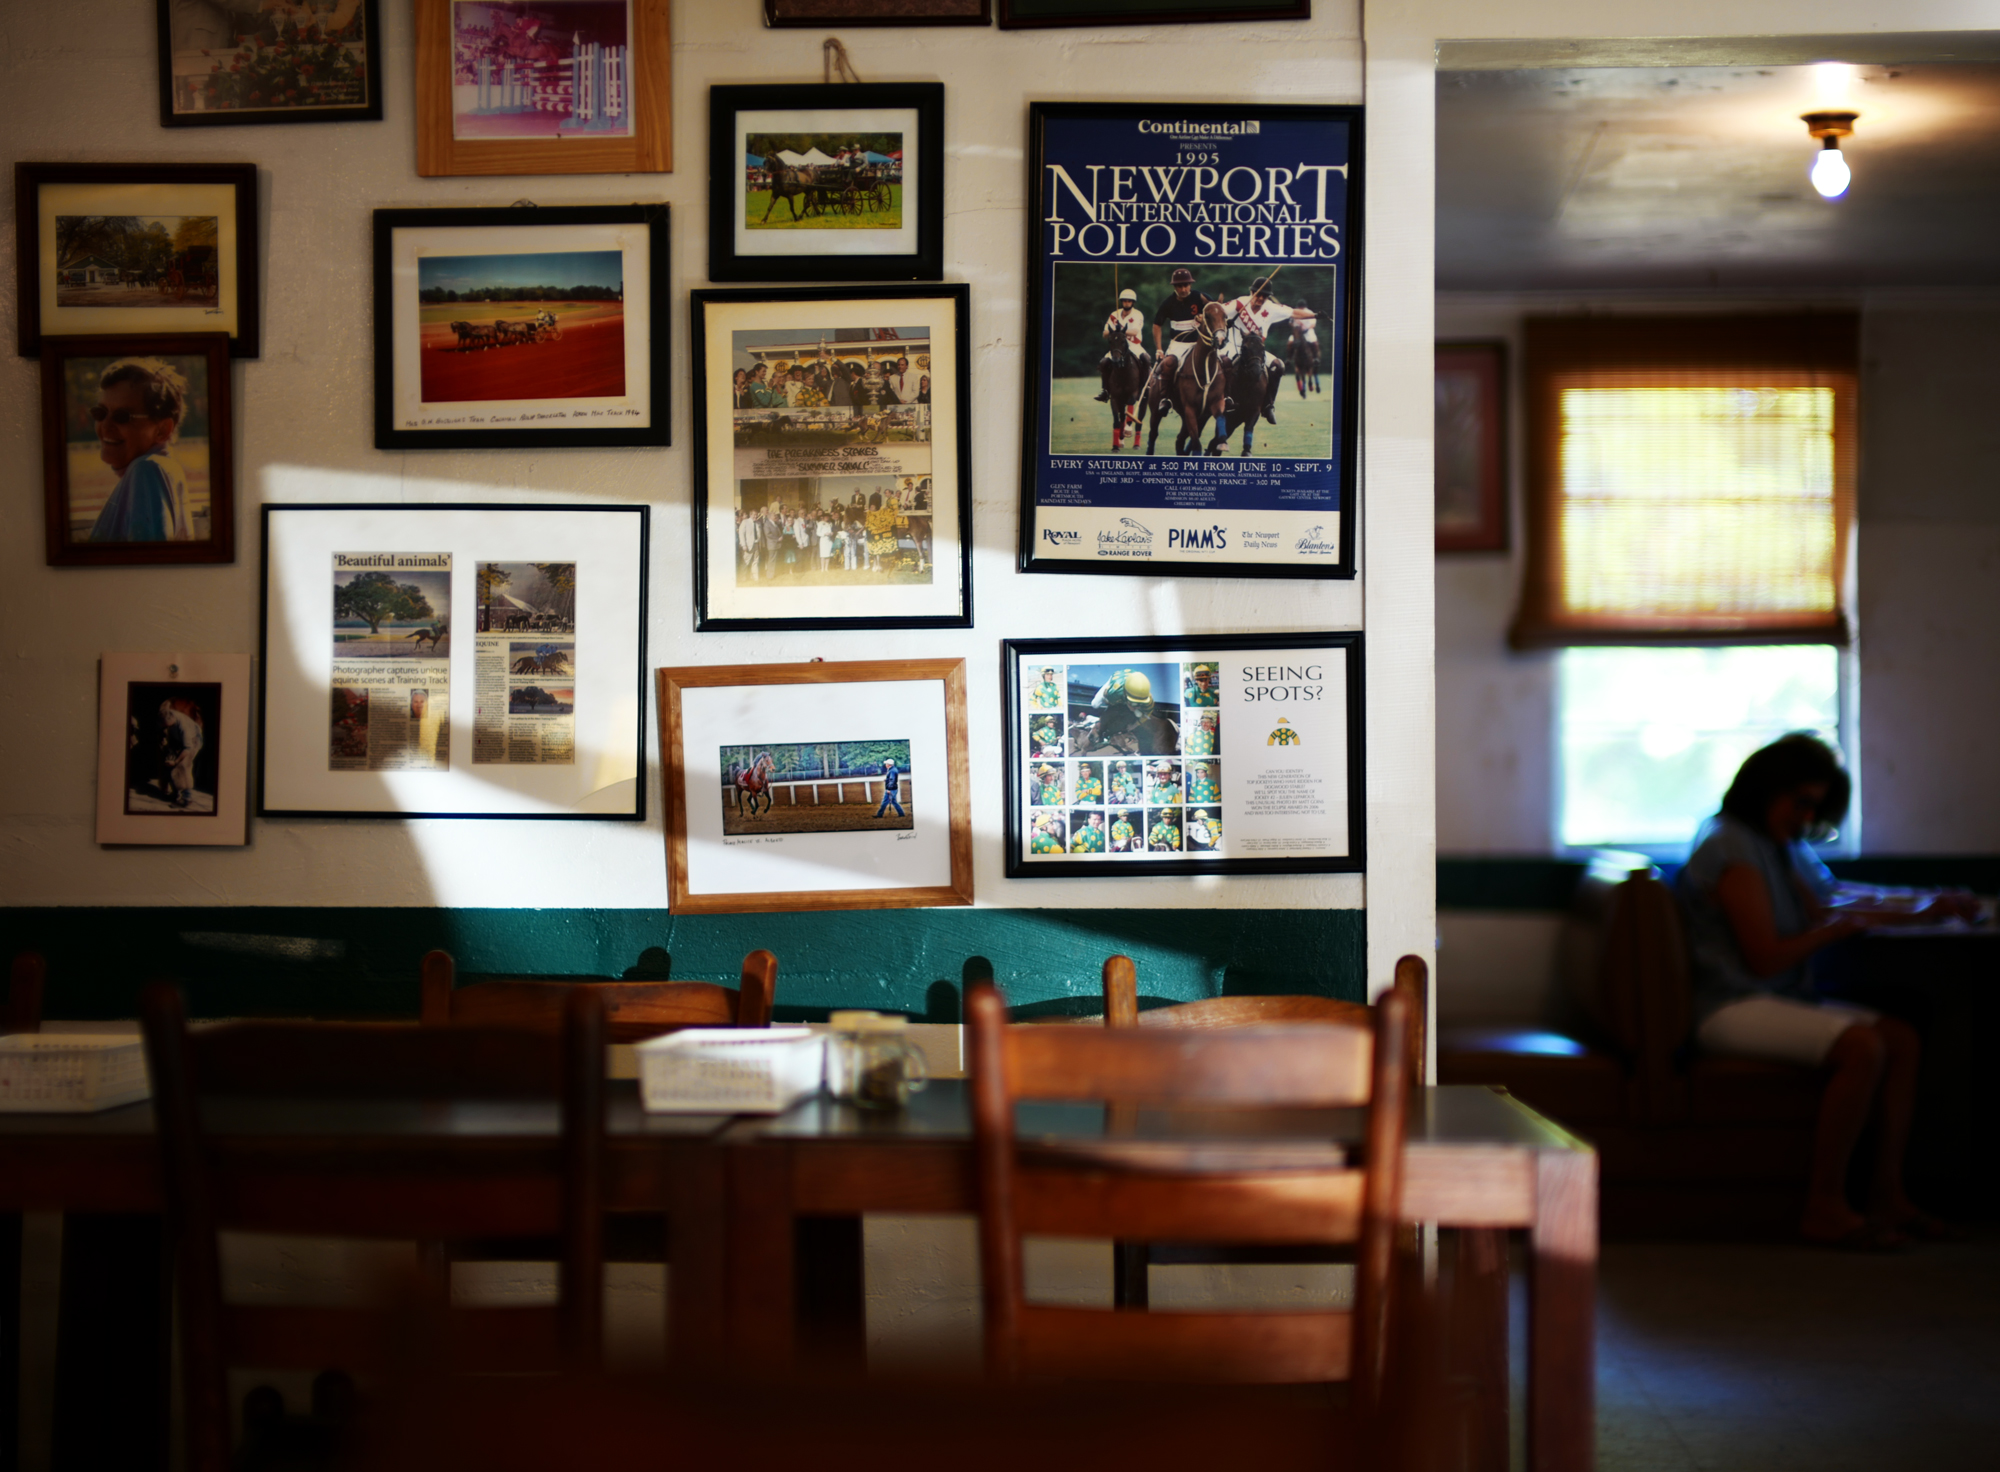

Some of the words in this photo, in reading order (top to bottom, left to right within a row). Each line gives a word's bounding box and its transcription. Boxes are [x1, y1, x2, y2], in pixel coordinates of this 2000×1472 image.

[1138, 120, 1246, 134] Continental
[1176, 152, 1219, 165] 1995
[1045, 162, 1348, 223] NEWPORT
[1099, 203, 1307, 223] INTERNATIONAL
[1049, 222, 1177, 256] POLO
[1194, 224, 1341, 258] SERIES
[1190, 304, 1198, 315] 3
[767, 449, 783, 459] THE
[784, 448, 840, 458] PREAKNESS
[842, 447, 879, 457] STAKES
[1050, 460, 1084, 469] EVERY
[1088, 461, 1144, 470] SATURDAY
[1161, 462, 1179, 471] 5:00
[1183, 462, 1199, 471] PM
[1203, 462, 1235, 471] FROM
[1238, 462, 1267, 473] JUNE
[1272, 463, 1282, 472] 10
[1294, 463, 1322, 472] SEPT.
[1326, 464, 1332, 472] 9
[1043, 529, 1082, 545] ROYAL
[1168, 525, 1227, 549] PIMM'S
[1242, 531, 1254, 539] The
[1255, 532, 1280, 540] Newport
[1243, 540, 1260, 549] Daily
[1295, 537, 1335, 550] Blanton's
[333, 665, 386, 676] Photographer
[386, 667, 419, 675] captures
[420, 666, 448, 675] unique
[1242, 665, 1323, 682] SEEING
[332, 677, 359, 686] equine
[396, 676, 427, 686] Training
[427, 676, 448, 684] Track
[1244, 685, 1324, 702] SPOTS?
